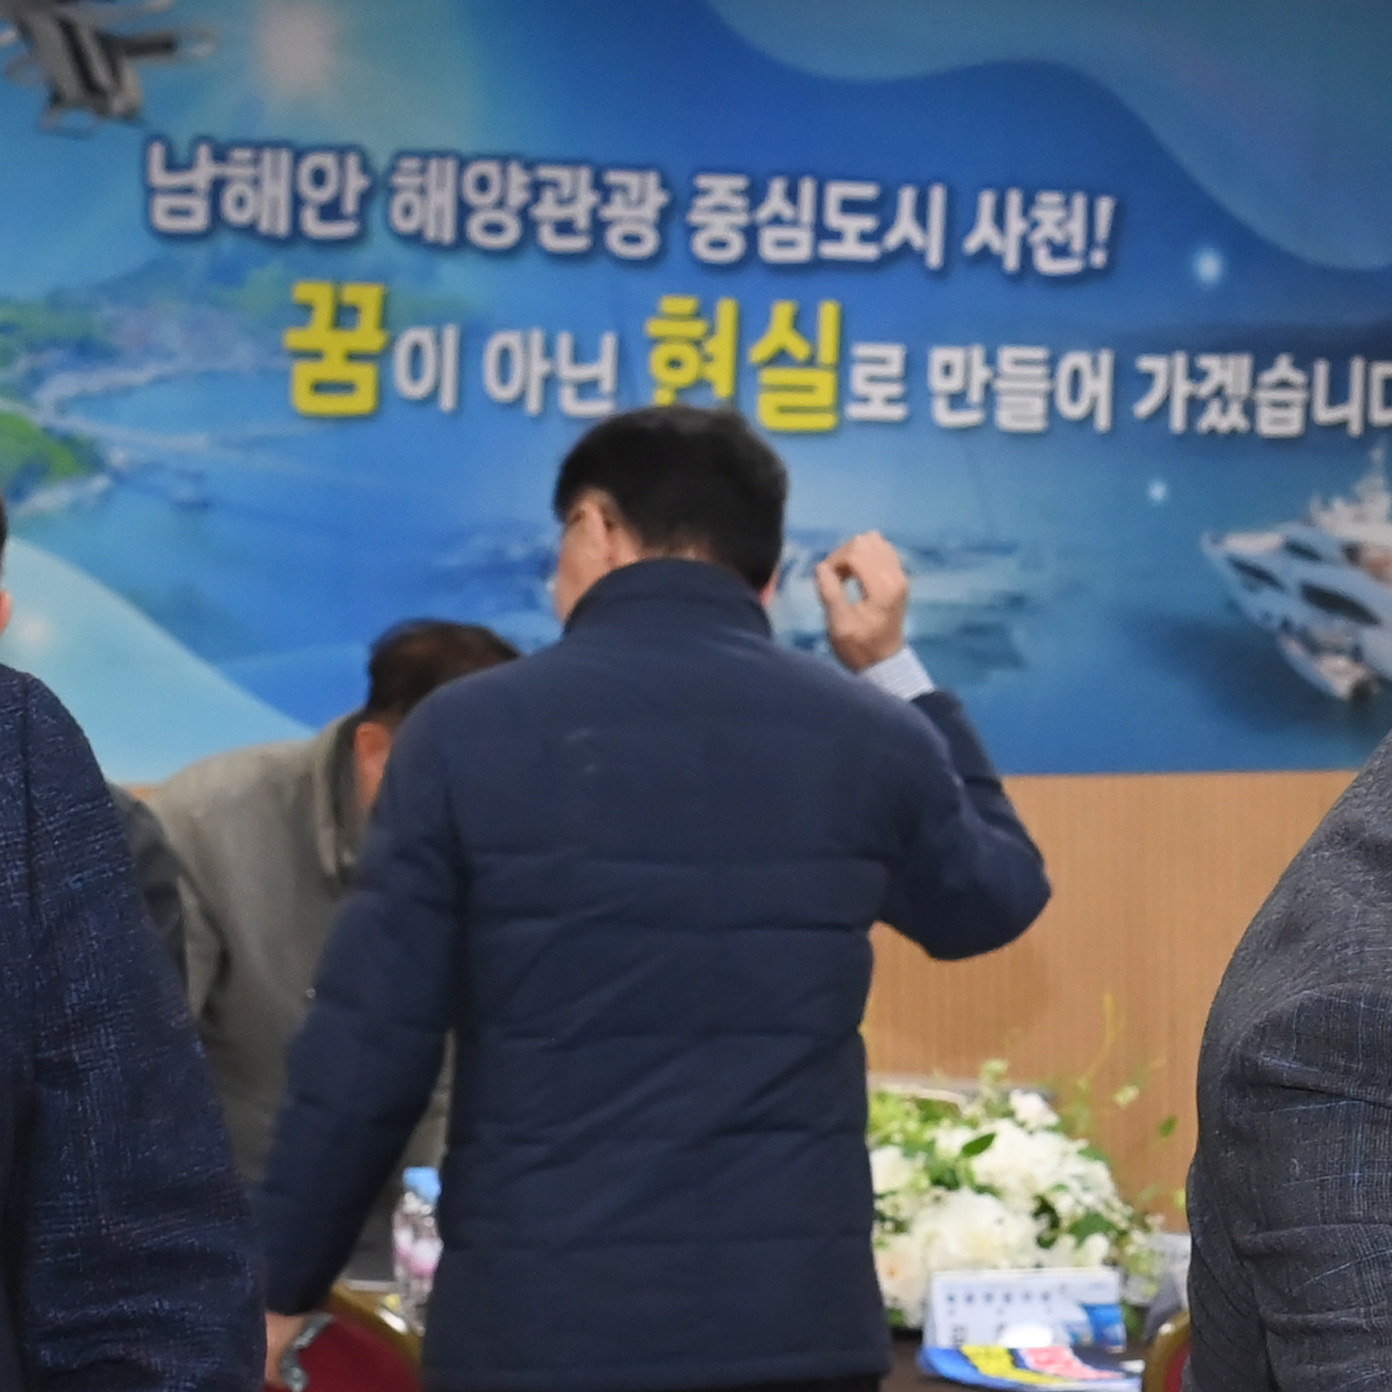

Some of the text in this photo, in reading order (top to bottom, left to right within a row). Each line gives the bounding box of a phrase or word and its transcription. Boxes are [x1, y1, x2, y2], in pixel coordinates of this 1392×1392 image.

[148, 141, 1116, 276] 남해안 해양관광 중심도시 사천!
[284, 281, 460, 416] 꿈이
[484, 329, 618, 417] 아닌
[646, 294, 908, 432] 현실로
[928, 344, 1114, 434] 만들어
